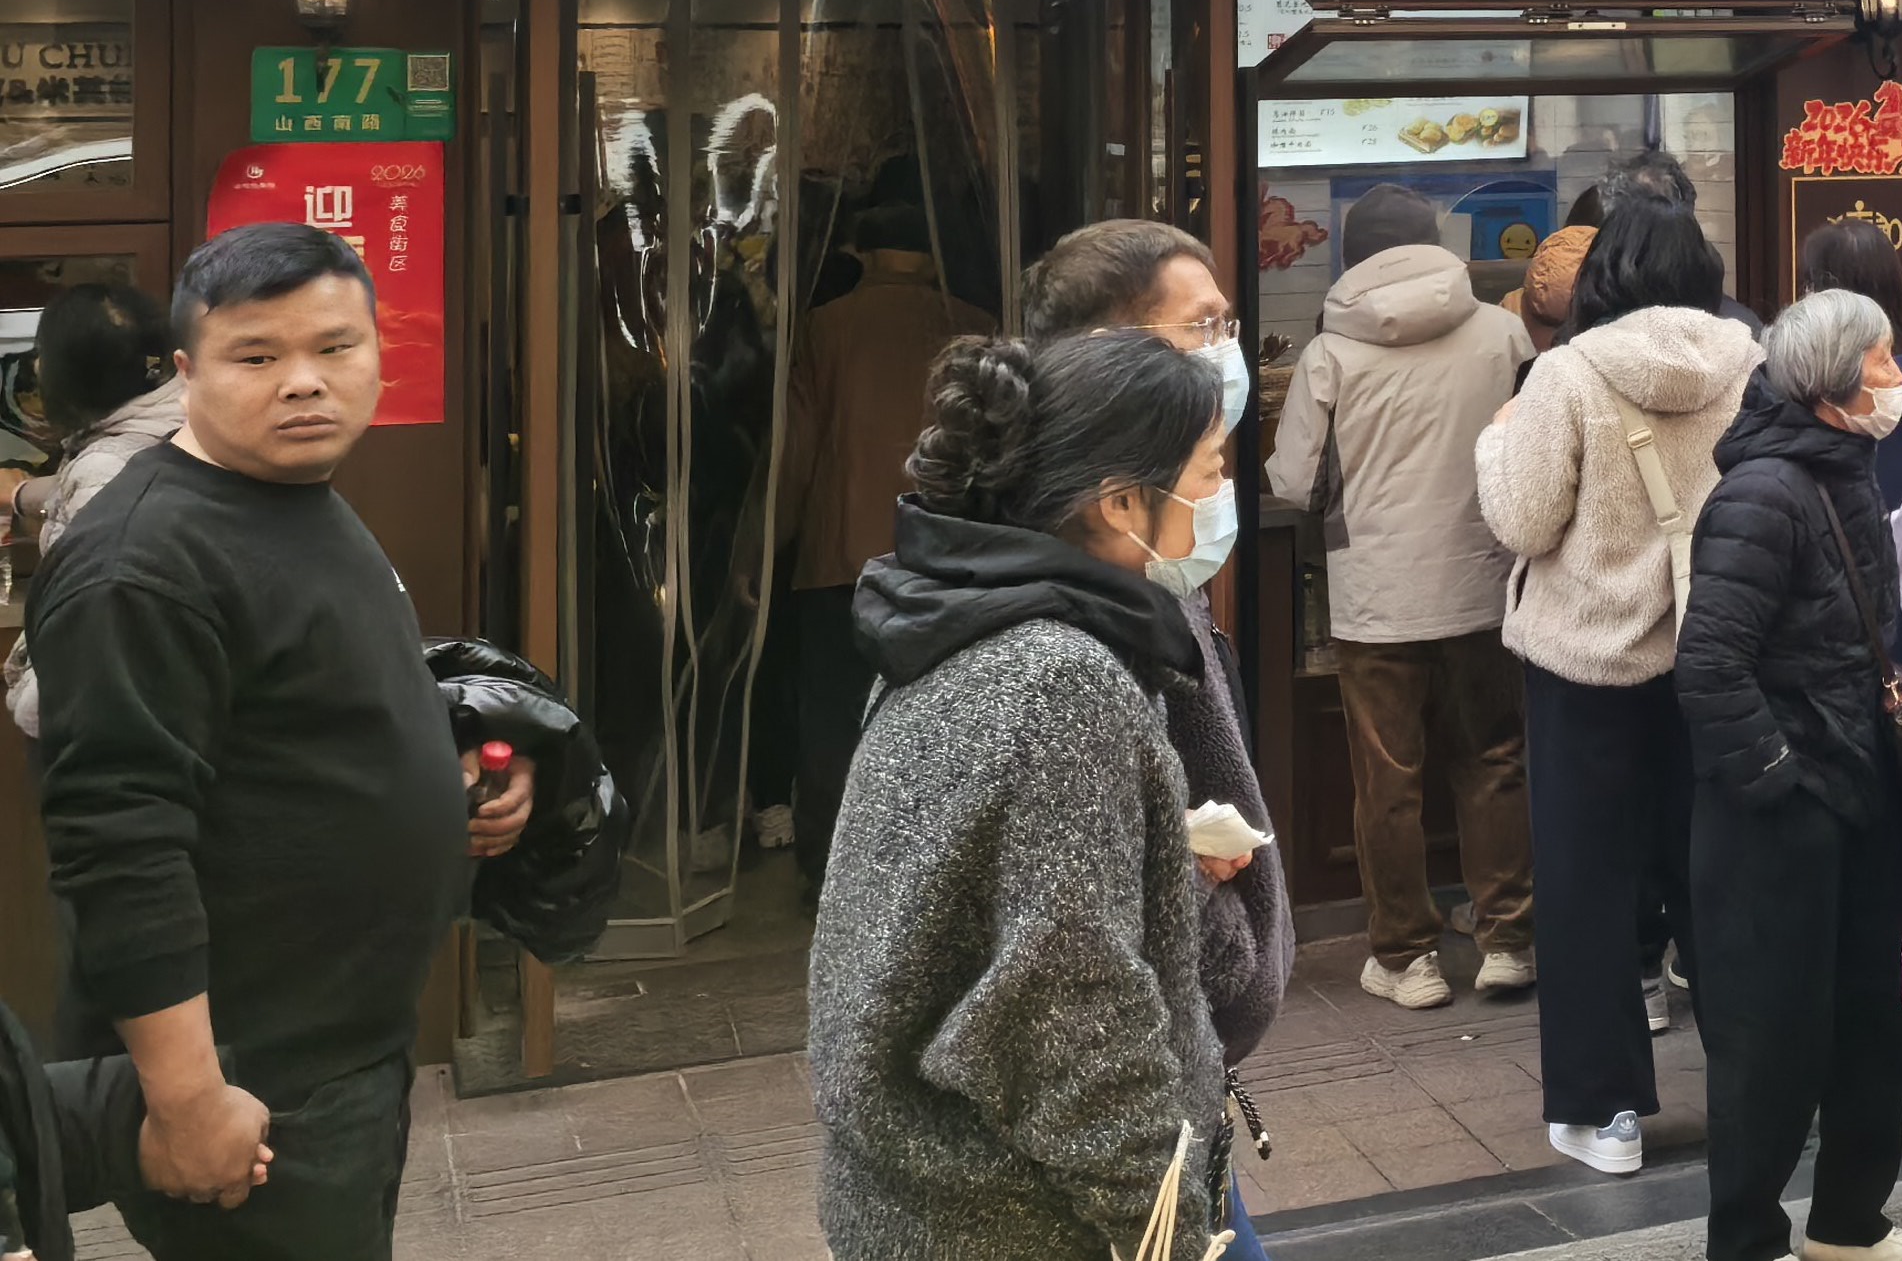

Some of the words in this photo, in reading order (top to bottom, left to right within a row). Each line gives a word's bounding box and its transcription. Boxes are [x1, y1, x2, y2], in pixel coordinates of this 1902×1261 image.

[275, 56, 381, 104] 177
[275, 113, 381, 132] 山西南路
[370, 164, 426, 181] 2026
